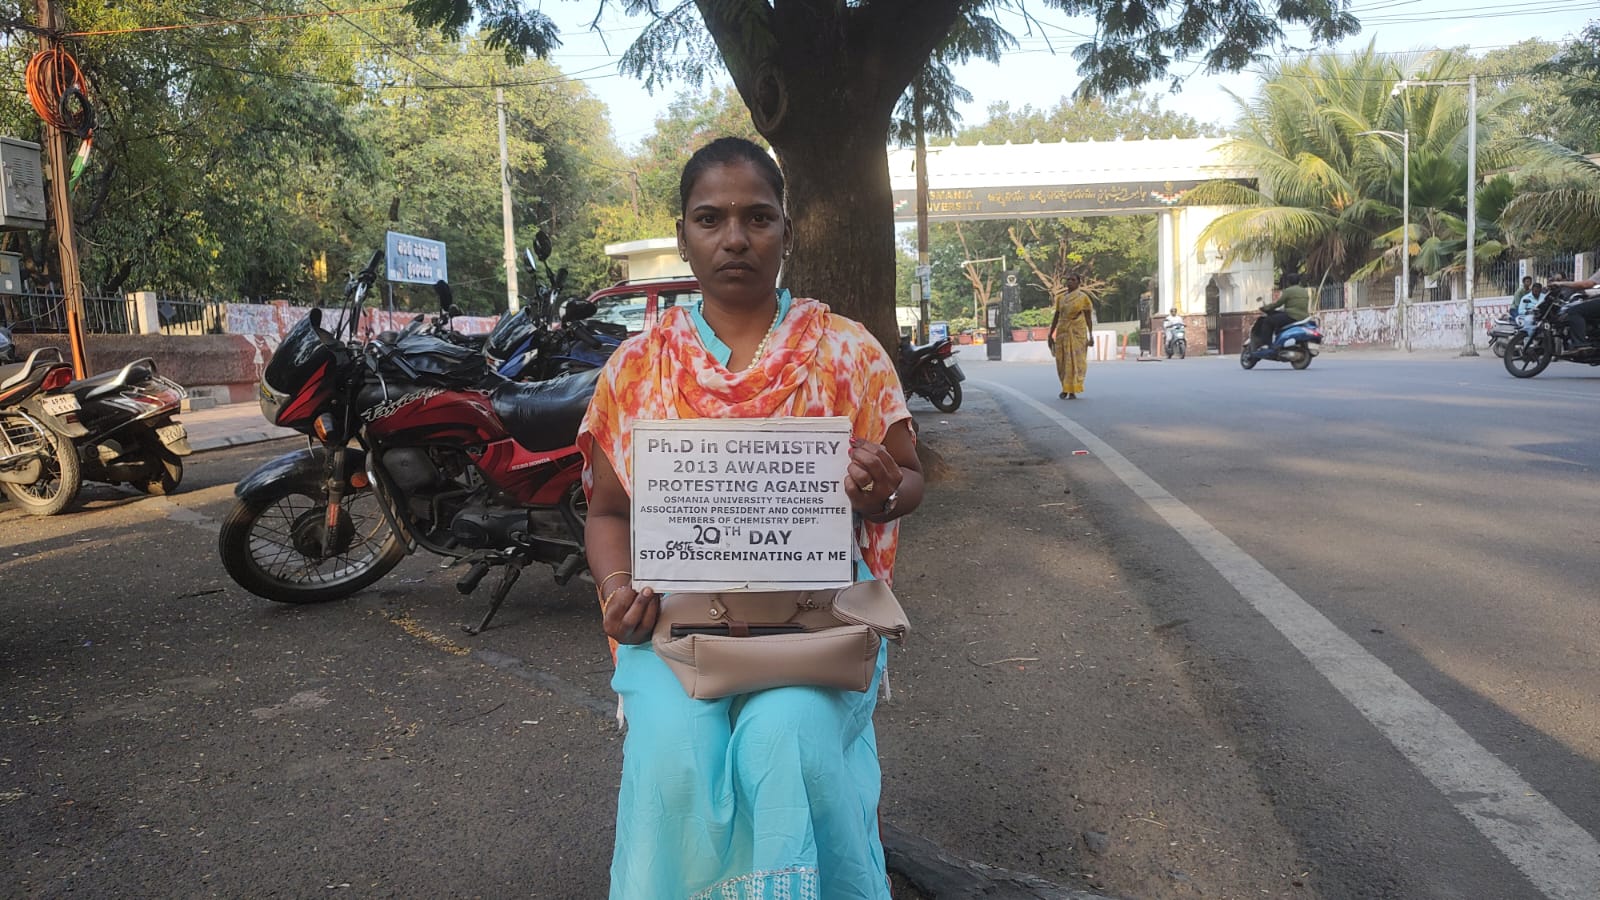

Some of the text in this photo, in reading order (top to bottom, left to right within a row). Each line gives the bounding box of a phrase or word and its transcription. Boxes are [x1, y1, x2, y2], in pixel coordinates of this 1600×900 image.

[929, 190, 973, 201] SMANIA
[648, 439, 840, 455] Ph.D in CHEMISTRY
[674, 460, 815, 474] 2013 AWARDEE
[648, 480, 839, 492] PROTESTING AGAINST
[664, 496, 709, 504] OSMANIA
[713, 496, 772, 504] UNIVERSITY
[750, 531, 792, 545] DAY
[666, 541, 694, 551] CASTE
[640, 551, 846, 561] STOP DISCREMINATING AT ME
